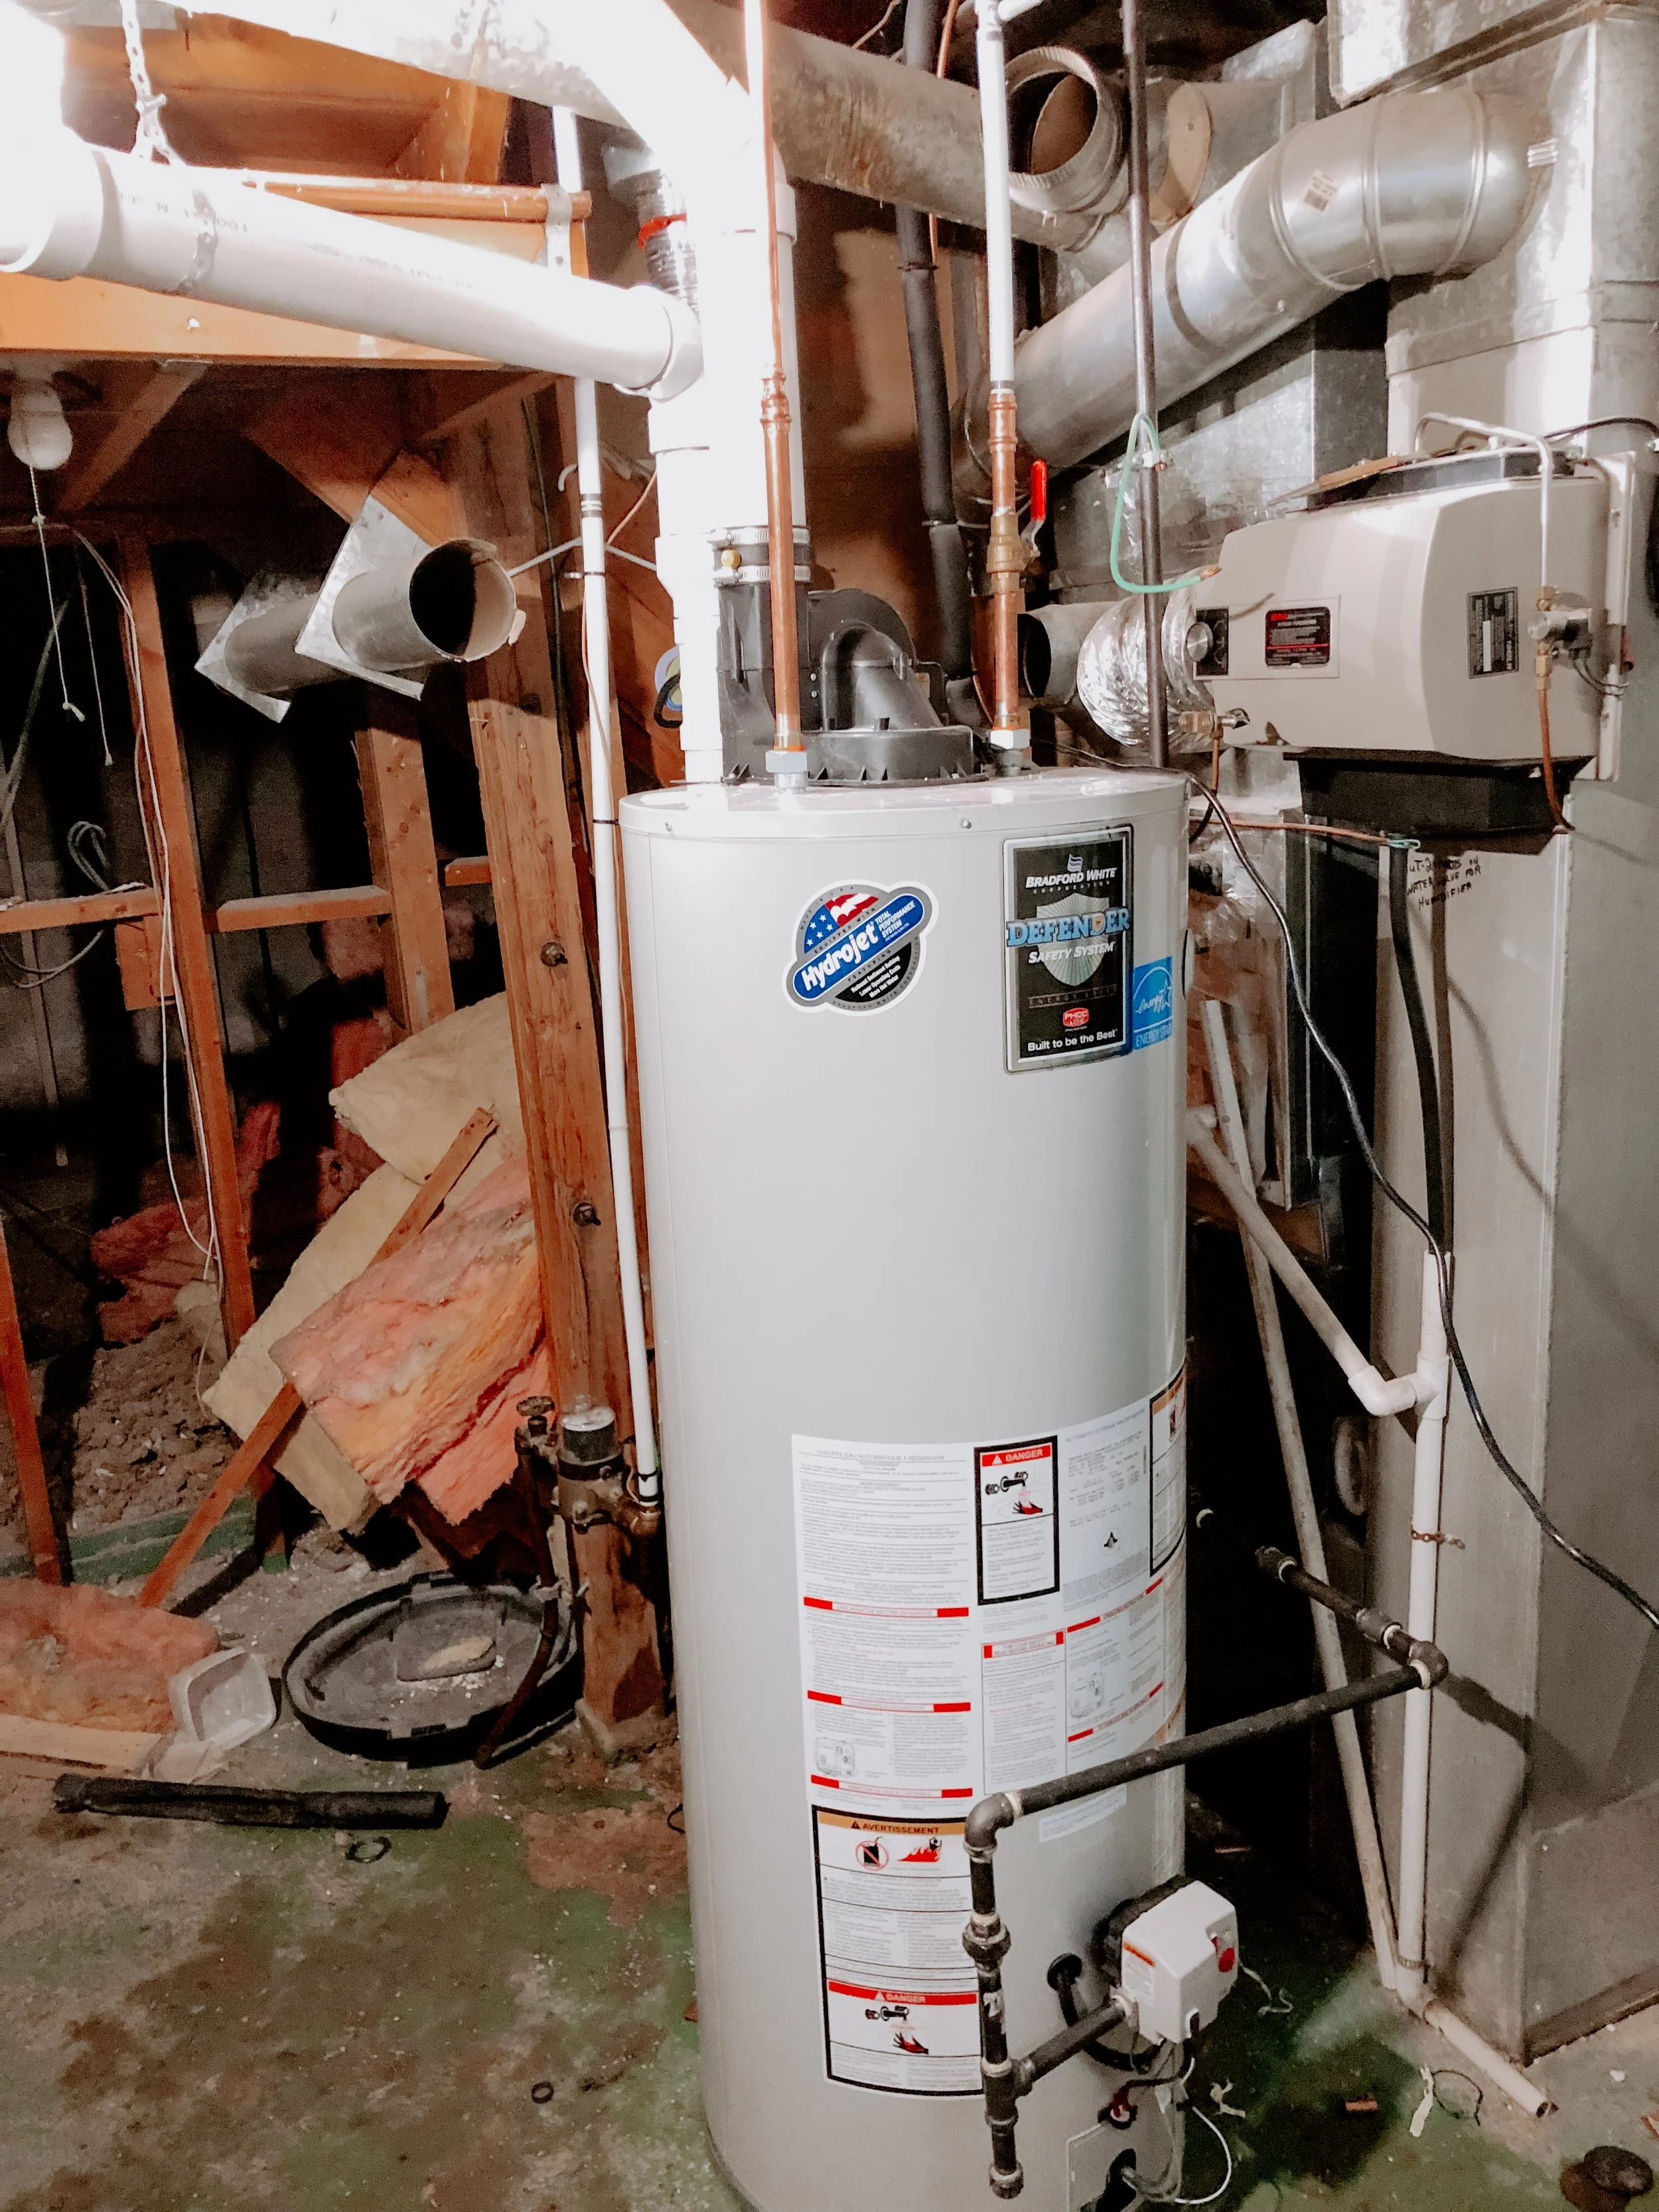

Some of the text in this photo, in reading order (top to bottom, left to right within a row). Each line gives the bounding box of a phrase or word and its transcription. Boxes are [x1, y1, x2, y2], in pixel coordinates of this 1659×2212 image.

[1025, 867, 1118, 889] BRADFORD WHITE
[874, 910, 892, 925] TOTAL
[878, 900, 916, 932] PERFORMANCE
[881, 919, 902, 938] SYSTEM
[1006, 907, 1131, 948] DEFENDER
[814, 924, 852, 954] EQUIPPED
[800, 921, 879, 992] Hydrojet
[1029, 942, 1115, 964] SAFETY SYSTEM
[847, 949, 892, 982] FEATURING
[1027, 1029, 1116, 1052] Built to be the Best
[1135, 1027, 1160, 1048] ENERGY
[1005, 1448, 1043, 1462] DANGER
[863, 1822, 940, 1834] AVERTISSEMENT
[886, 1993, 926, 2004] DANGER
